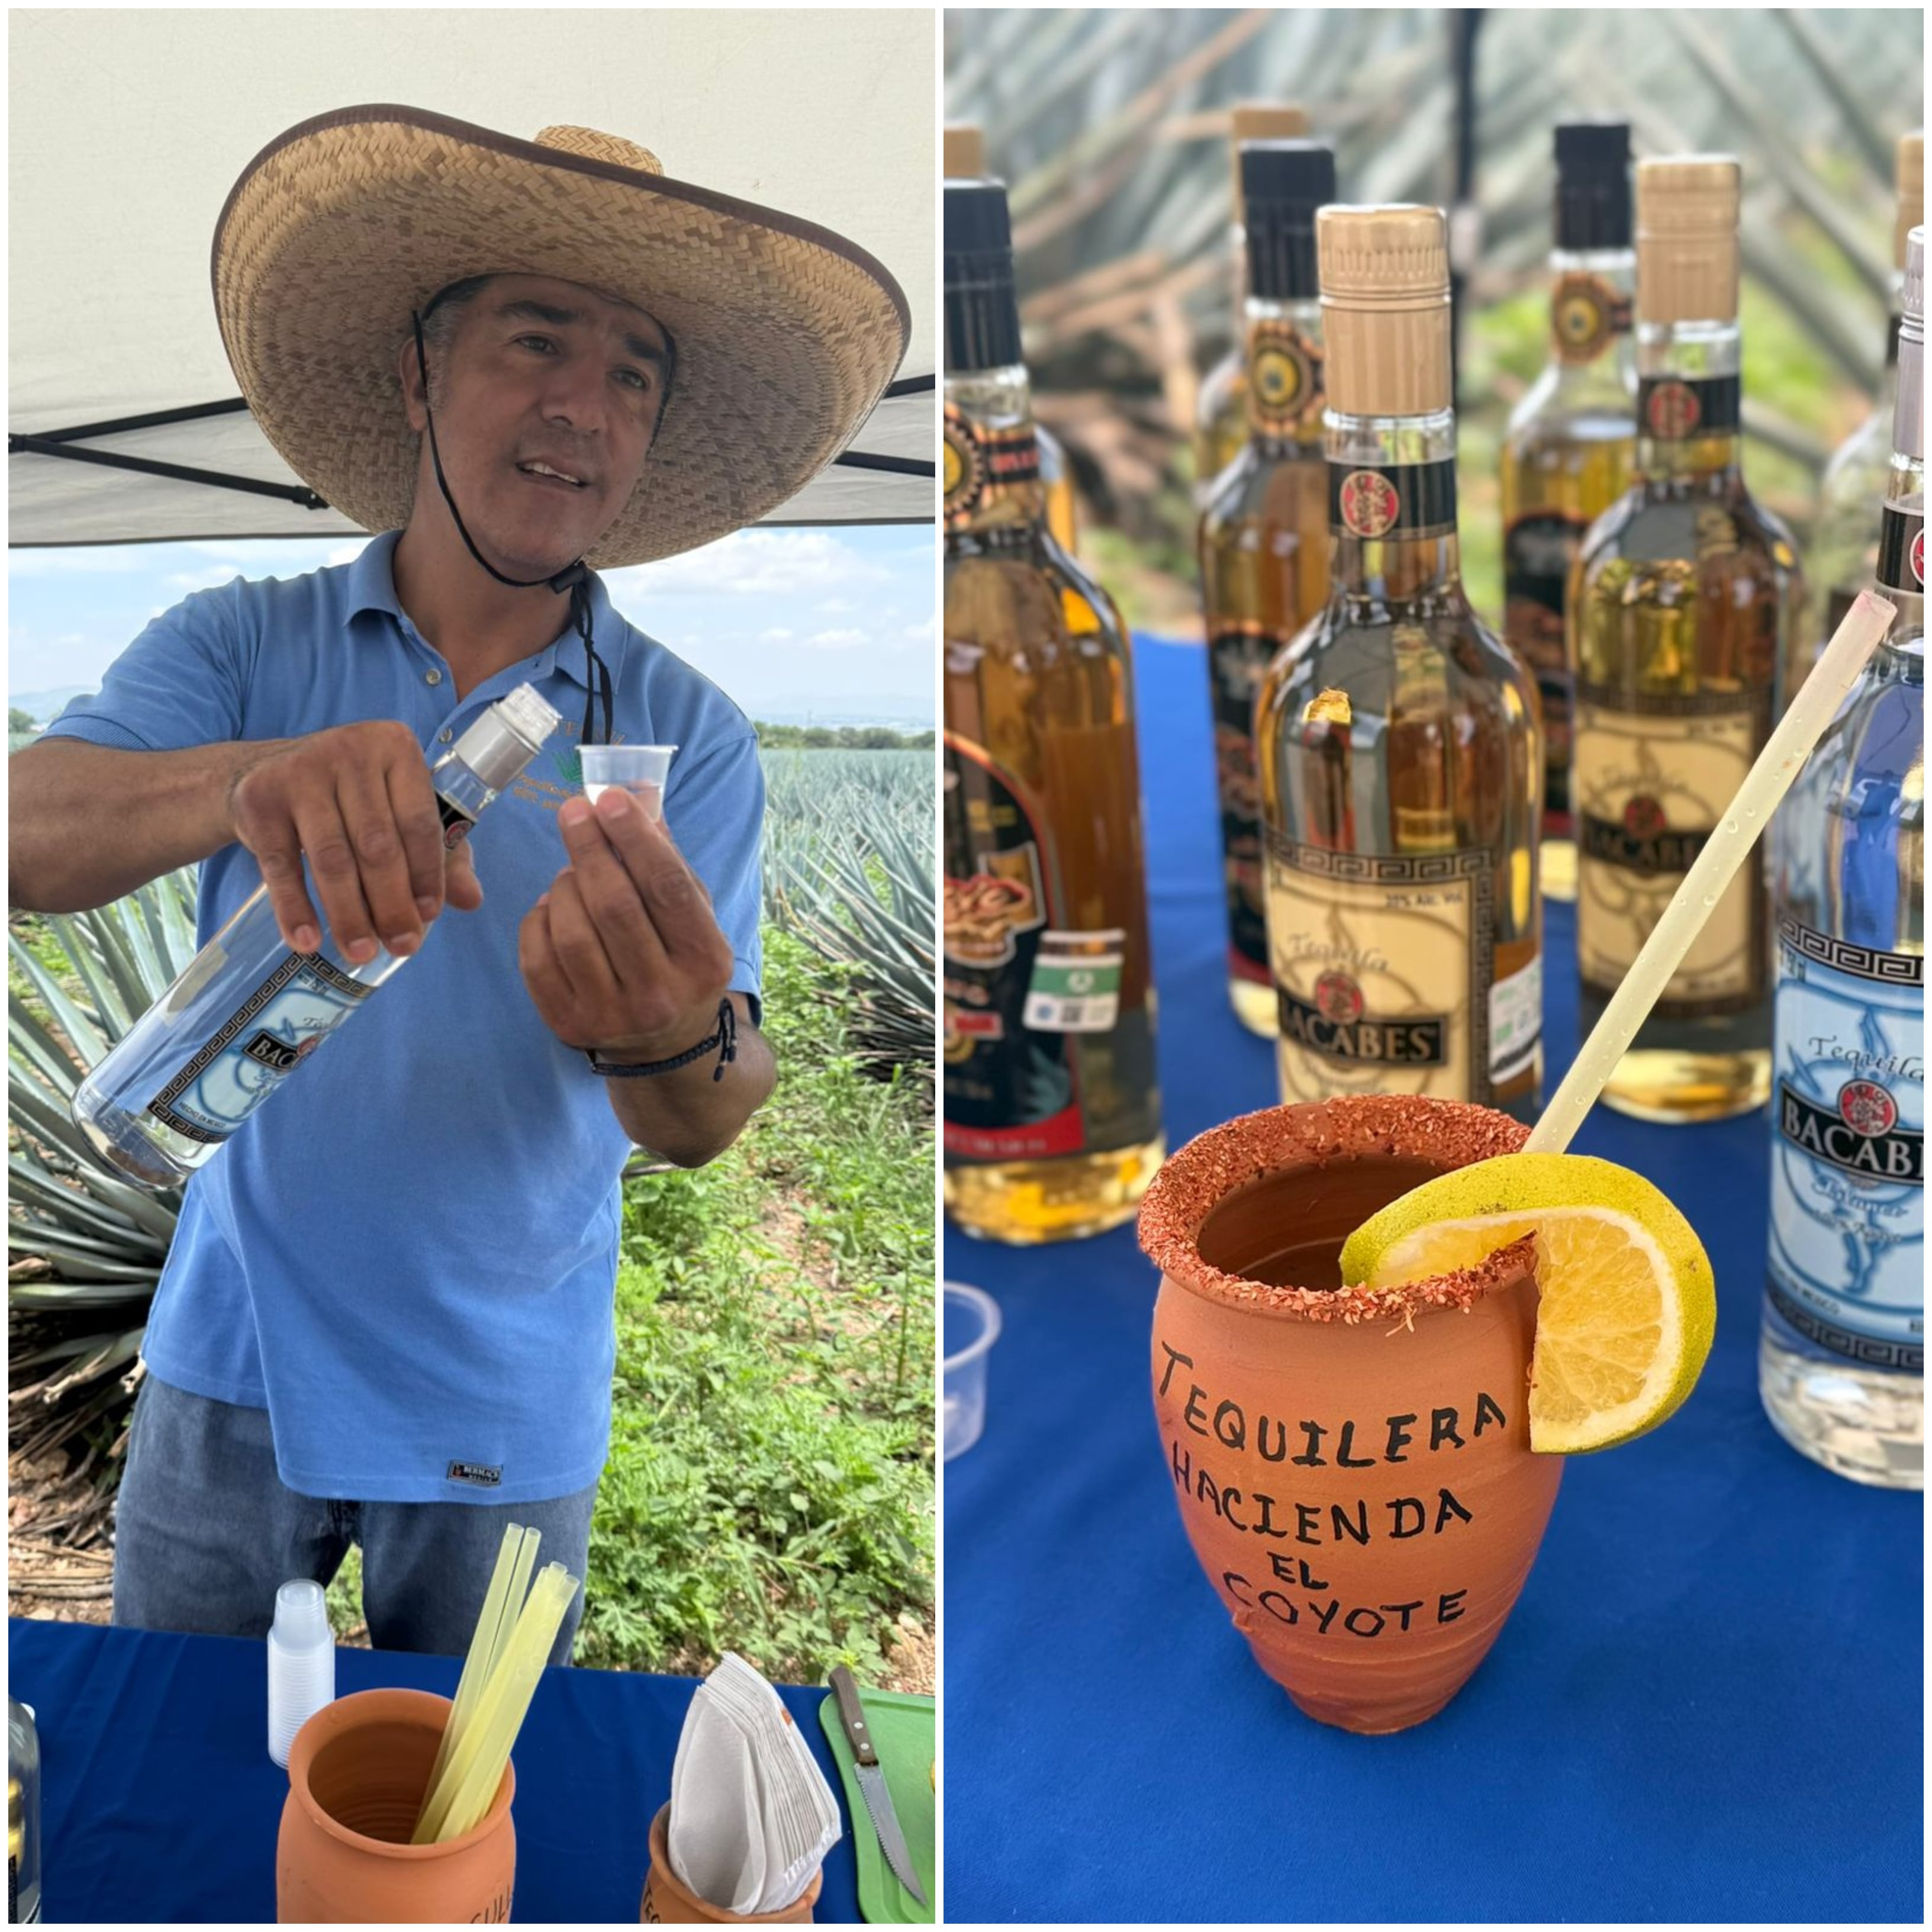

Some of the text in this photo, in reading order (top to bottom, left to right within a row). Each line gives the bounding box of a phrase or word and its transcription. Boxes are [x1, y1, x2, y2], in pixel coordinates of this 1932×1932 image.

[1160, 1340, 1506, 1468] TEQUILERA
[1172, 1440, 1474, 1546] HACIENDA
[1222, 1572, 1467, 1638] COYOTE
[1266, 1550, 1329, 1590] EL
